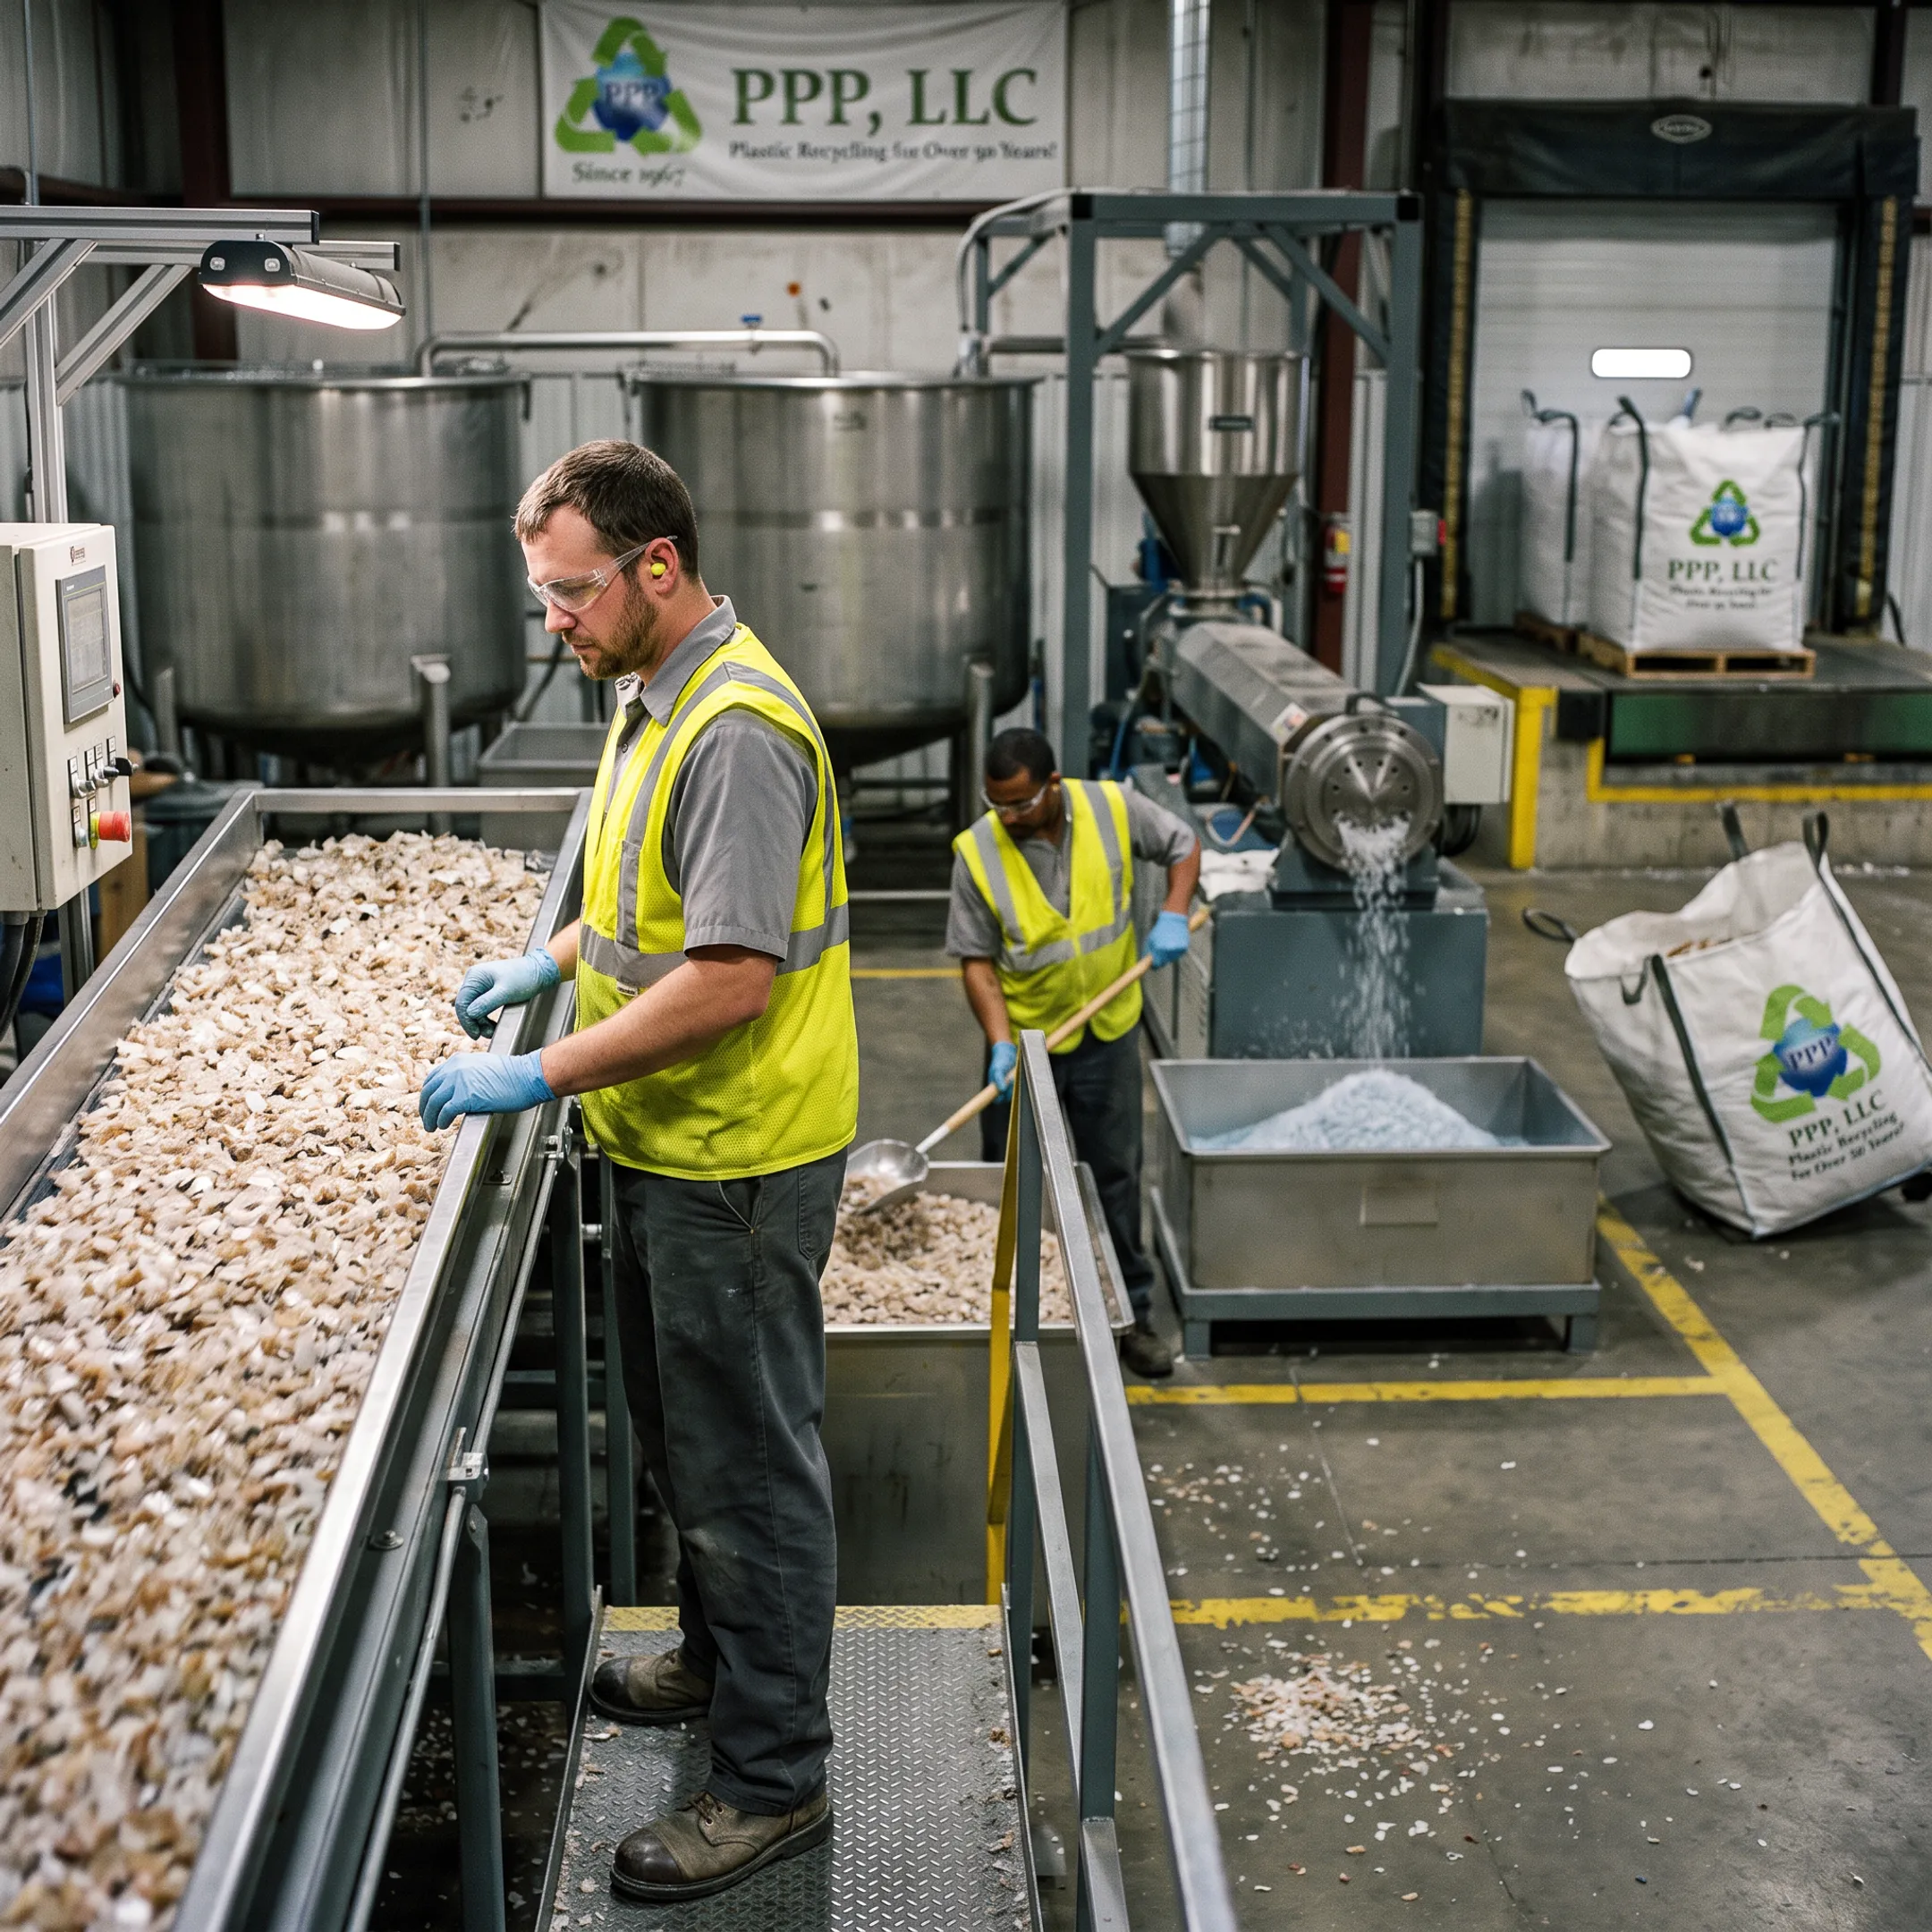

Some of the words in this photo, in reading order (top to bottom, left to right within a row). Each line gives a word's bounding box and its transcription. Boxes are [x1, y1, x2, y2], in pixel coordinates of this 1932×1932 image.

[730, 68, 882, 136] PPP,
[906, 67, 1038, 125] LLC
[729, 140, 792, 160] Plastic
[797, 140, 887, 164] Recycling
[922, 140, 970, 160] Over
[572, 161, 631, 183] Since
[1668, 559, 1723, 584] PPP,
[1733, 558, 1779, 583] LLC
[1788, 1036, 1834, 1071] PPP
[1787, 1117, 1840, 1149] PPP,
[1843, 1089, 1887, 1125] LLC
